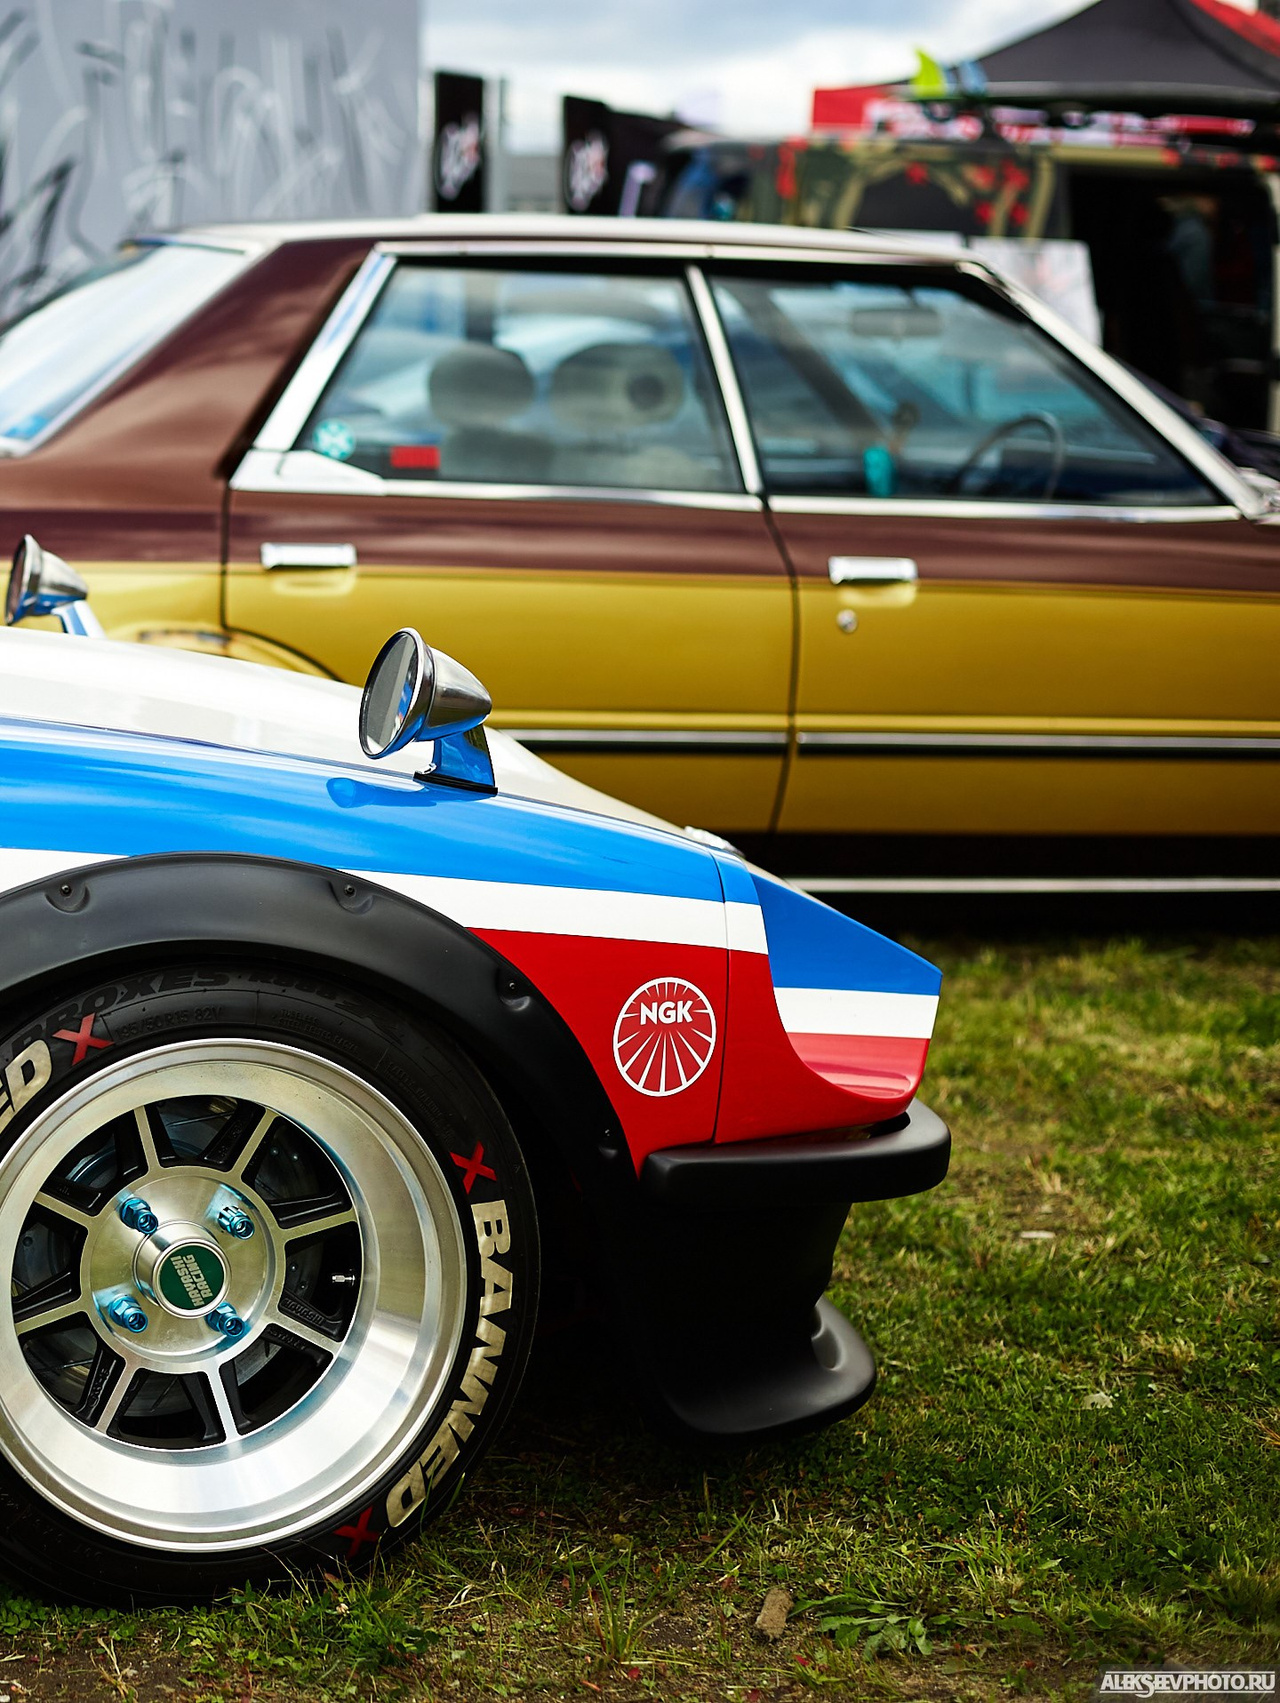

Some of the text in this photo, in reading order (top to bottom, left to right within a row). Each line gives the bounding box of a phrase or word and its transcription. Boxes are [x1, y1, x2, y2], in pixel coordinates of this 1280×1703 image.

[639, 1000, 694, 1026] NGK
[170, 1254, 206, 1308] HAYASHI
[182, 1253, 214, 1299] RACING
[387, 1200, 514, 1528] BANNED
